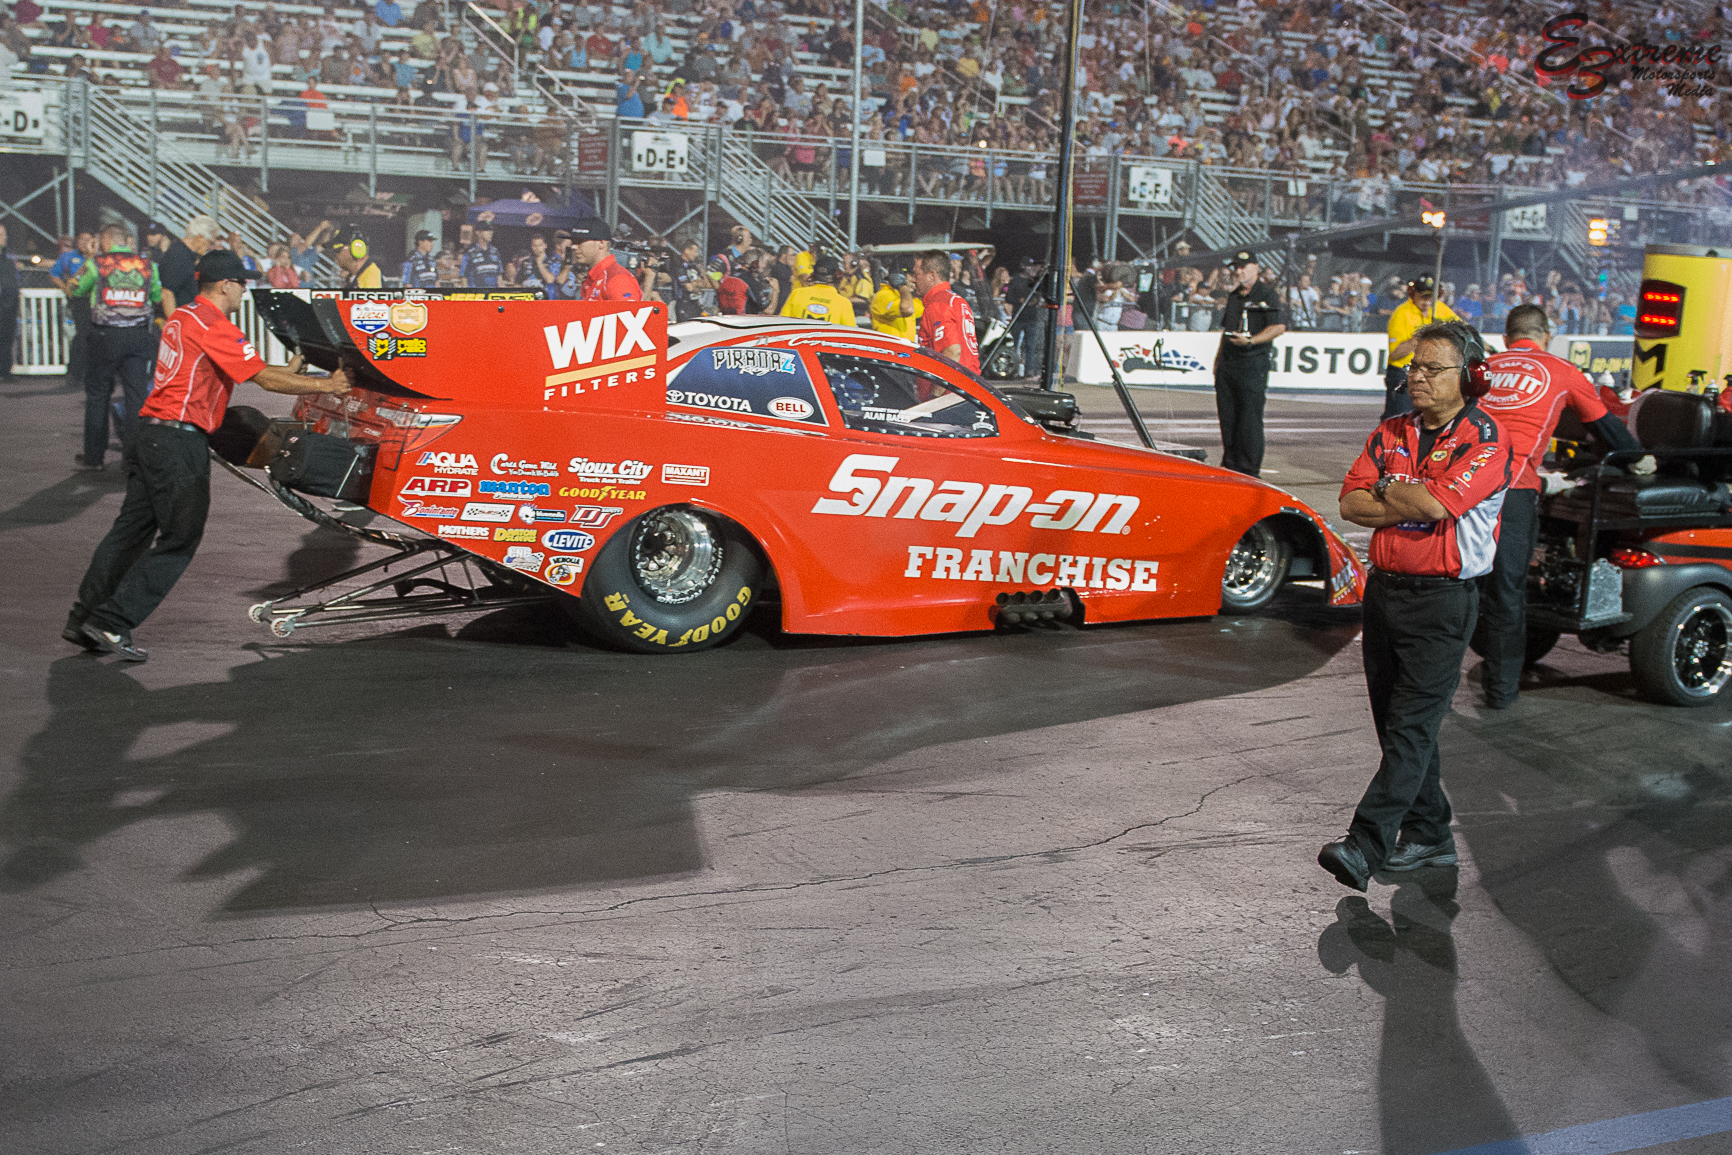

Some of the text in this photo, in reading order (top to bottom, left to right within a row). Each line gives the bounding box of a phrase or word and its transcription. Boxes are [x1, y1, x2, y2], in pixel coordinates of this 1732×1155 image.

[543, 306, 657, 370] WIX
[544, 368, 656, 401] FILTERS
[1491, 373, 1543, 394] WN IT
[685, 391, 752, 412] TOYOTA
[776, 402, 806, 413] BELL
[427, 452, 478, 468] AQUA
[567, 457, 617, 474] Sioux
[619, 460, 653, 479] City
[434, 467, 478, 475] HYDRATE
[665, 466, 707, 477] MAXANT
[405, 479, 469, 493] ARP
[480, 481, 550, 496] manton
[811, 454, 1140, 537] Snap-on
[438, 525, 489, 536] MOTHERS
[544, 530, 594, 548] CLEVITE
[904, 546, 1159, 592] FRANCHISE
